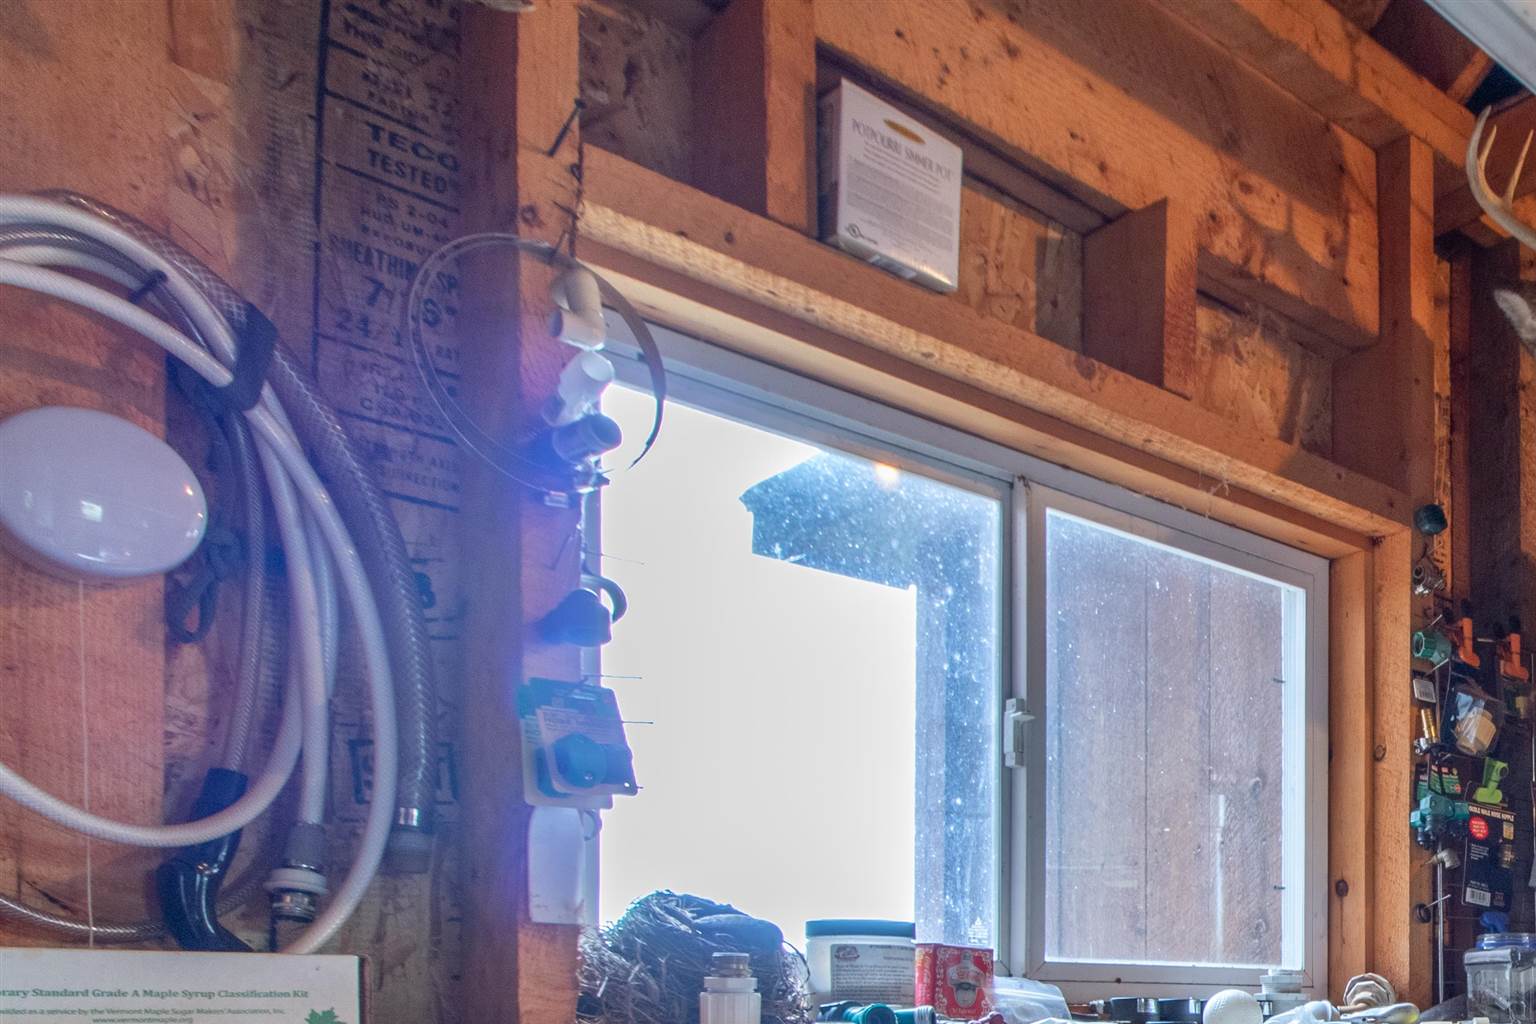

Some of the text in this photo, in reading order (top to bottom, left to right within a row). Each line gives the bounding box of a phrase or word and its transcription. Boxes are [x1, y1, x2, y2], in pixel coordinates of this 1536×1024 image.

[367, 149, 447, 194] TESTED
[31, 988, 89, 998] Standard
[92, 989, 128, 998] Grade
[131, 990, 140, 998] A
[143, 990, 178, 999] Maple
[182, 990, 215, 999] Syrup
[218, 990, 291, 998] Classification
[293, 990, 309, 998] Kit
